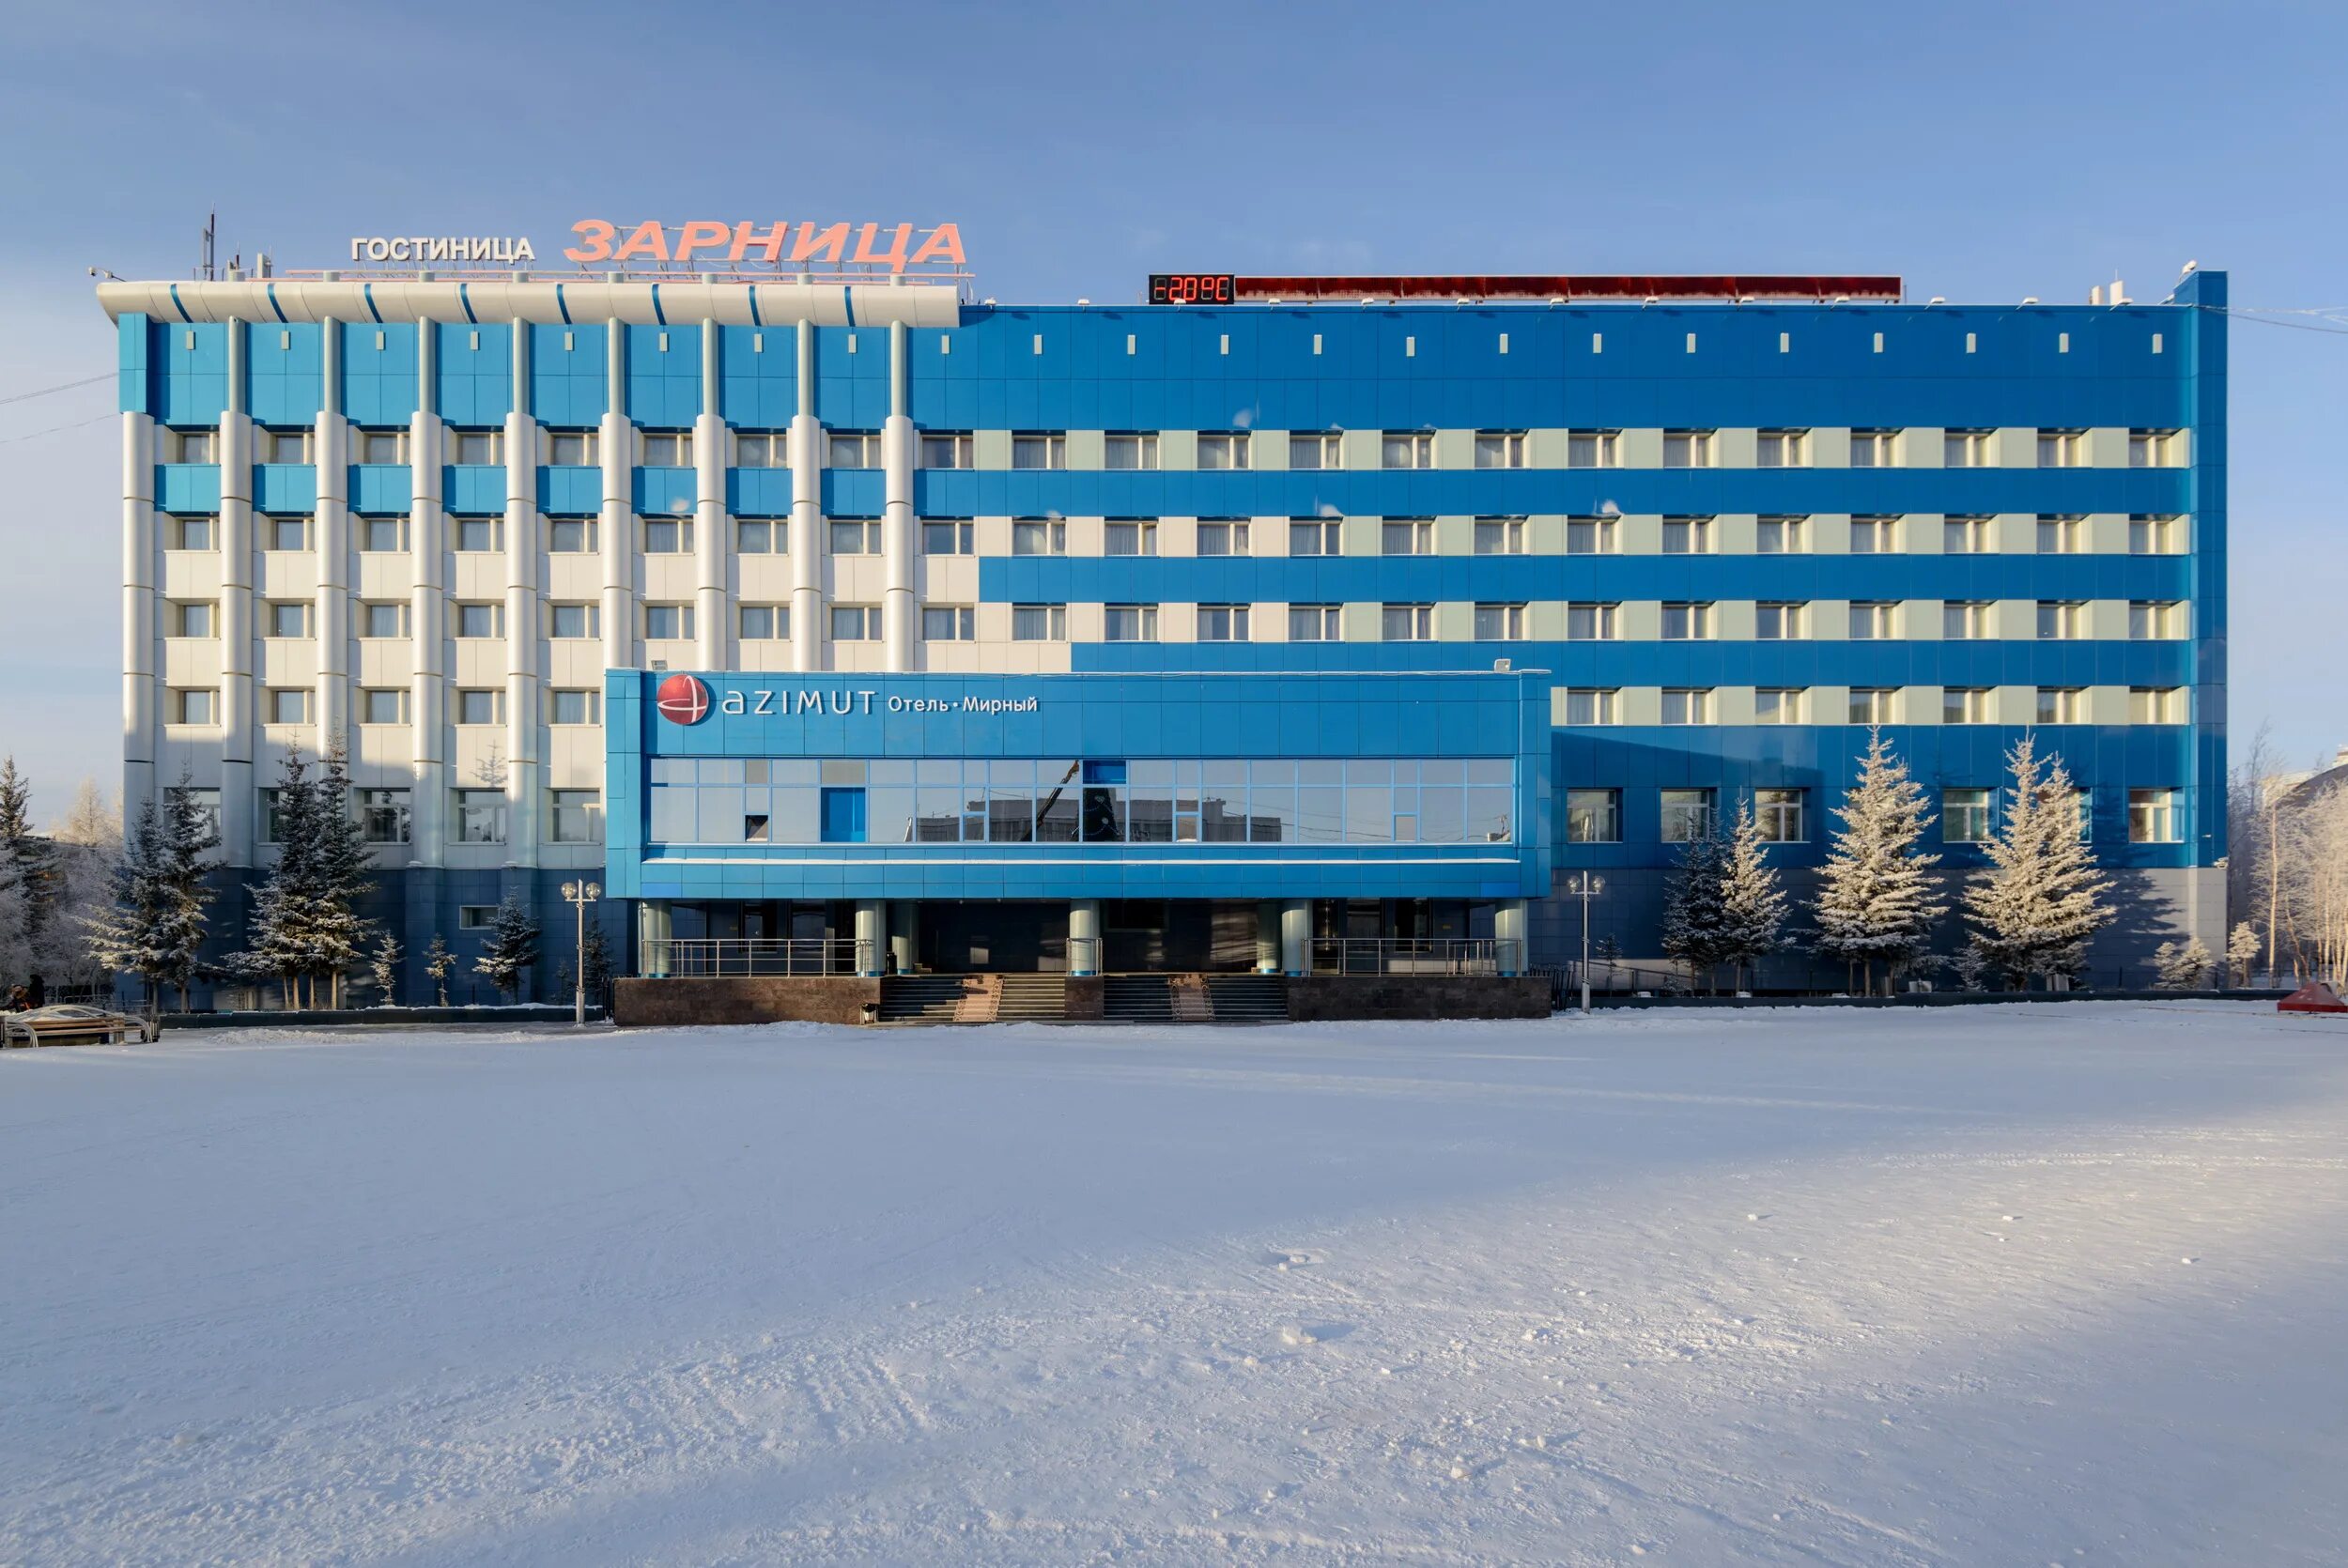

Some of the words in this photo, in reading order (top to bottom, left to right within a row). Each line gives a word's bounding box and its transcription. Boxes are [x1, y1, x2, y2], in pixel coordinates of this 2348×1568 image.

[351, 237, 535, 264] ГОСТИНИЦА
[564, 220, 966, 273] ЗАРНИЦА
[888, 696, 949, 712] Отель
[963, 696, 1038, 715] Мирный
